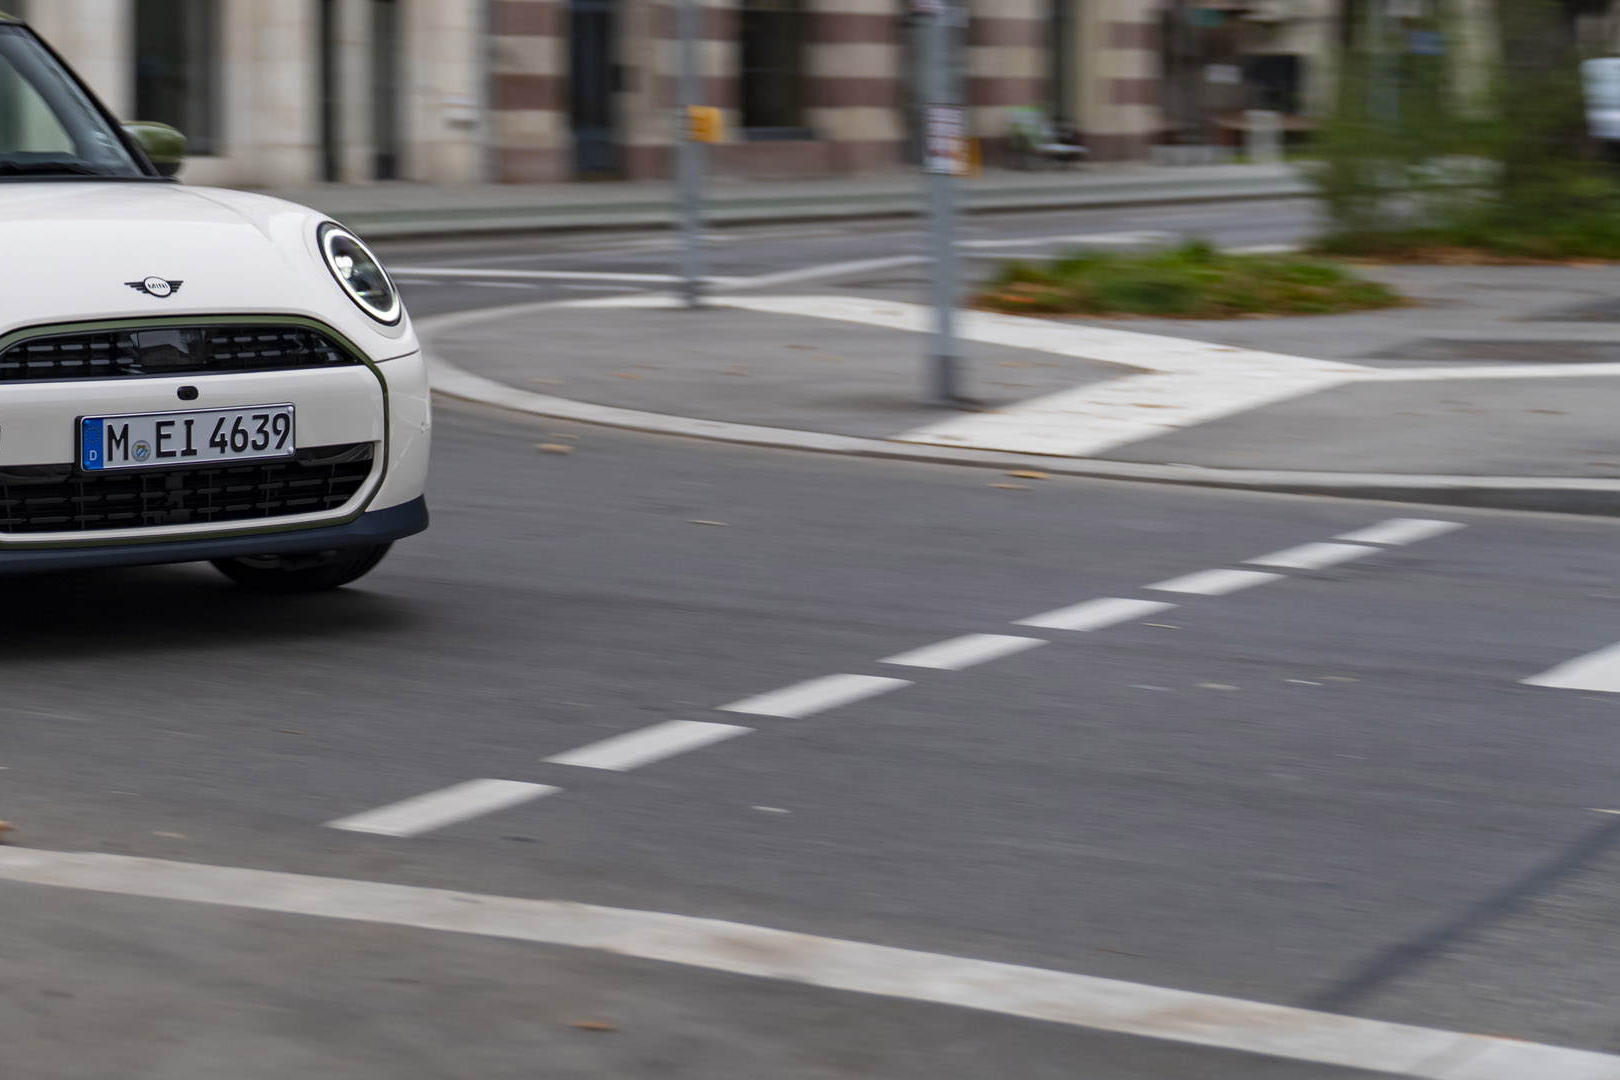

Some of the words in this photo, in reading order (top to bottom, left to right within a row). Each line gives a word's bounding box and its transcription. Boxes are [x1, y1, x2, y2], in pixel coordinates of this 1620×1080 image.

[107, 423, 129, 462] M
[155, 419, 198, 459] EI
[209, 413, 291, 454] 4639
[89, 449, 98, 461] D
